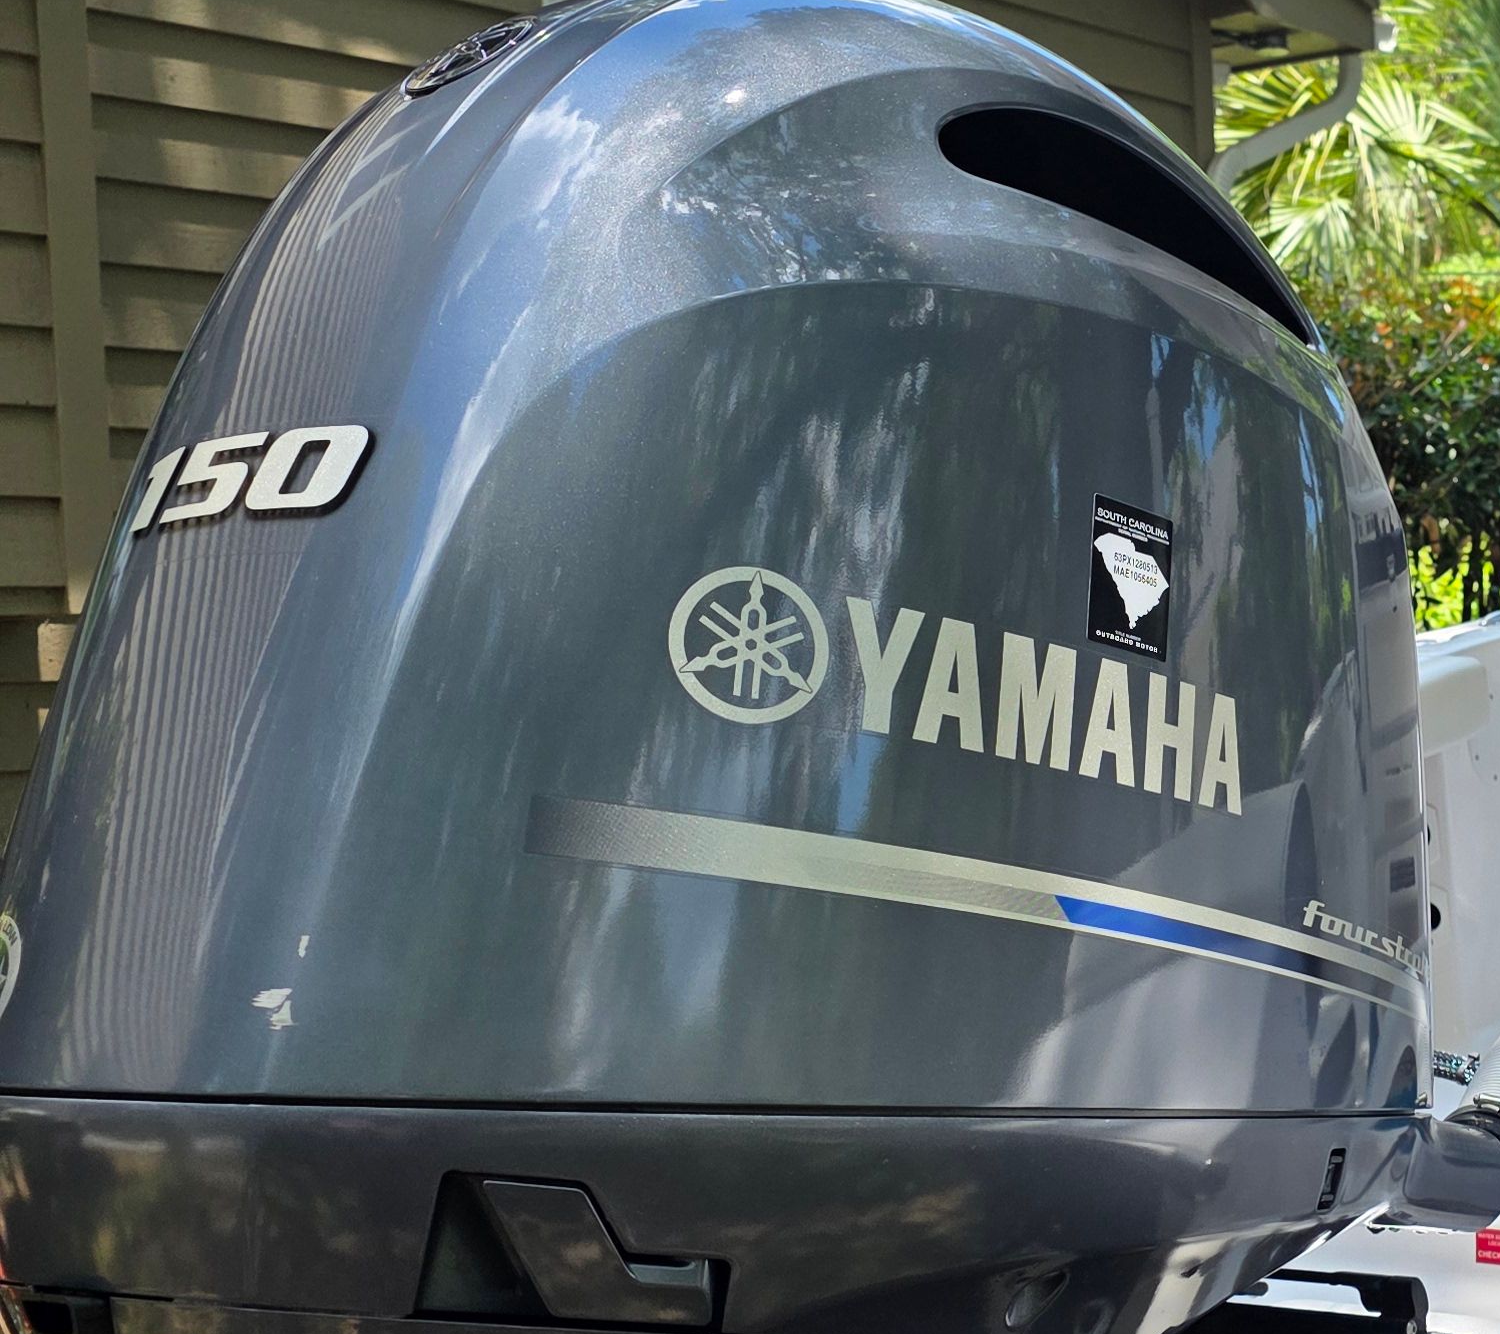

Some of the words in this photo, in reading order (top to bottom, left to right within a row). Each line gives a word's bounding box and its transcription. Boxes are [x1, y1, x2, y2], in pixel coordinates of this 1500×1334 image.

[130, 424, 369, 533] 150
[1097, 507, 1127, 525] SOUTH
[1128, 518, 1169, 540] CAROLINA
[1095, 629, 1134, 646] OUTBOARD
[1135, 641, 1158, 654] MOTOR
[846, 596, 1242, 816] YAMAHA
